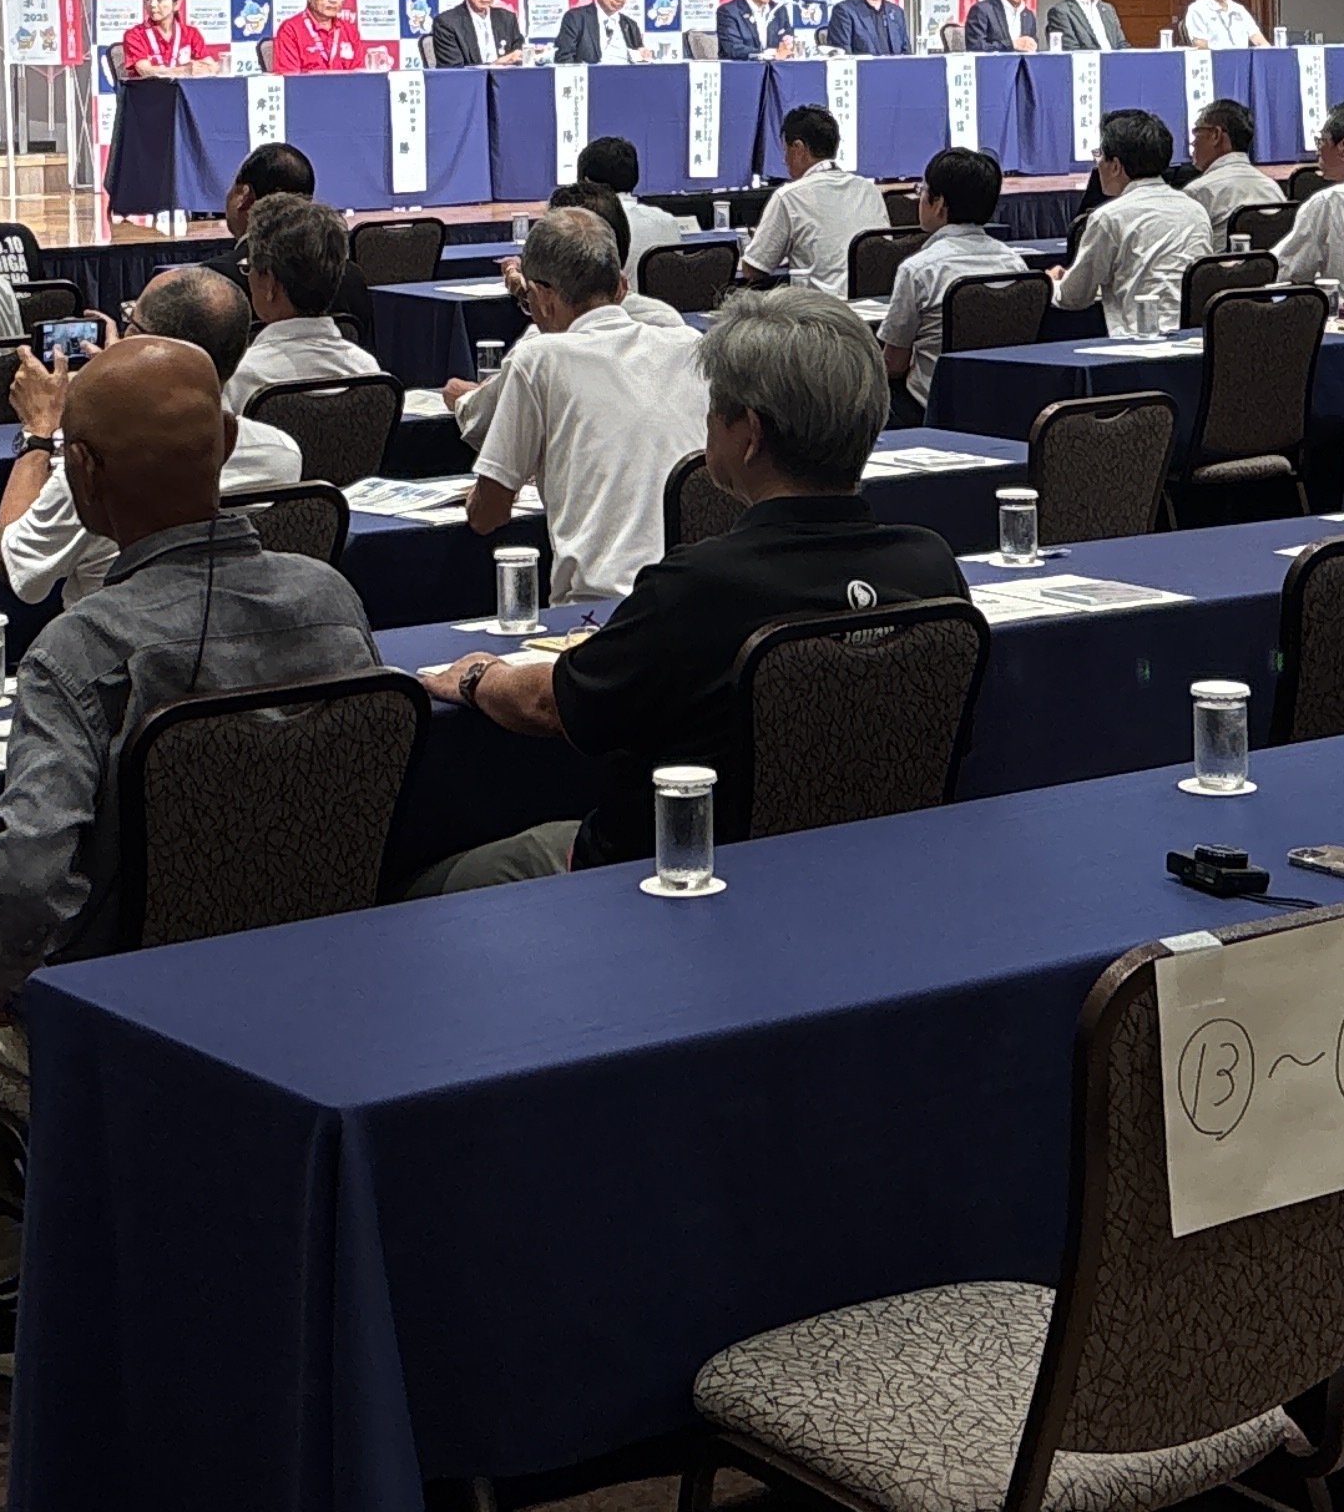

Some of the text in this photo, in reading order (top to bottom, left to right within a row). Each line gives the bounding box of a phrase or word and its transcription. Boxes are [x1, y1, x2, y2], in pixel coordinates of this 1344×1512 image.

[23, 12, 48, 22] 2025
[236, 60, 261, 72] 202
[405, 56, 420, 68] 20
